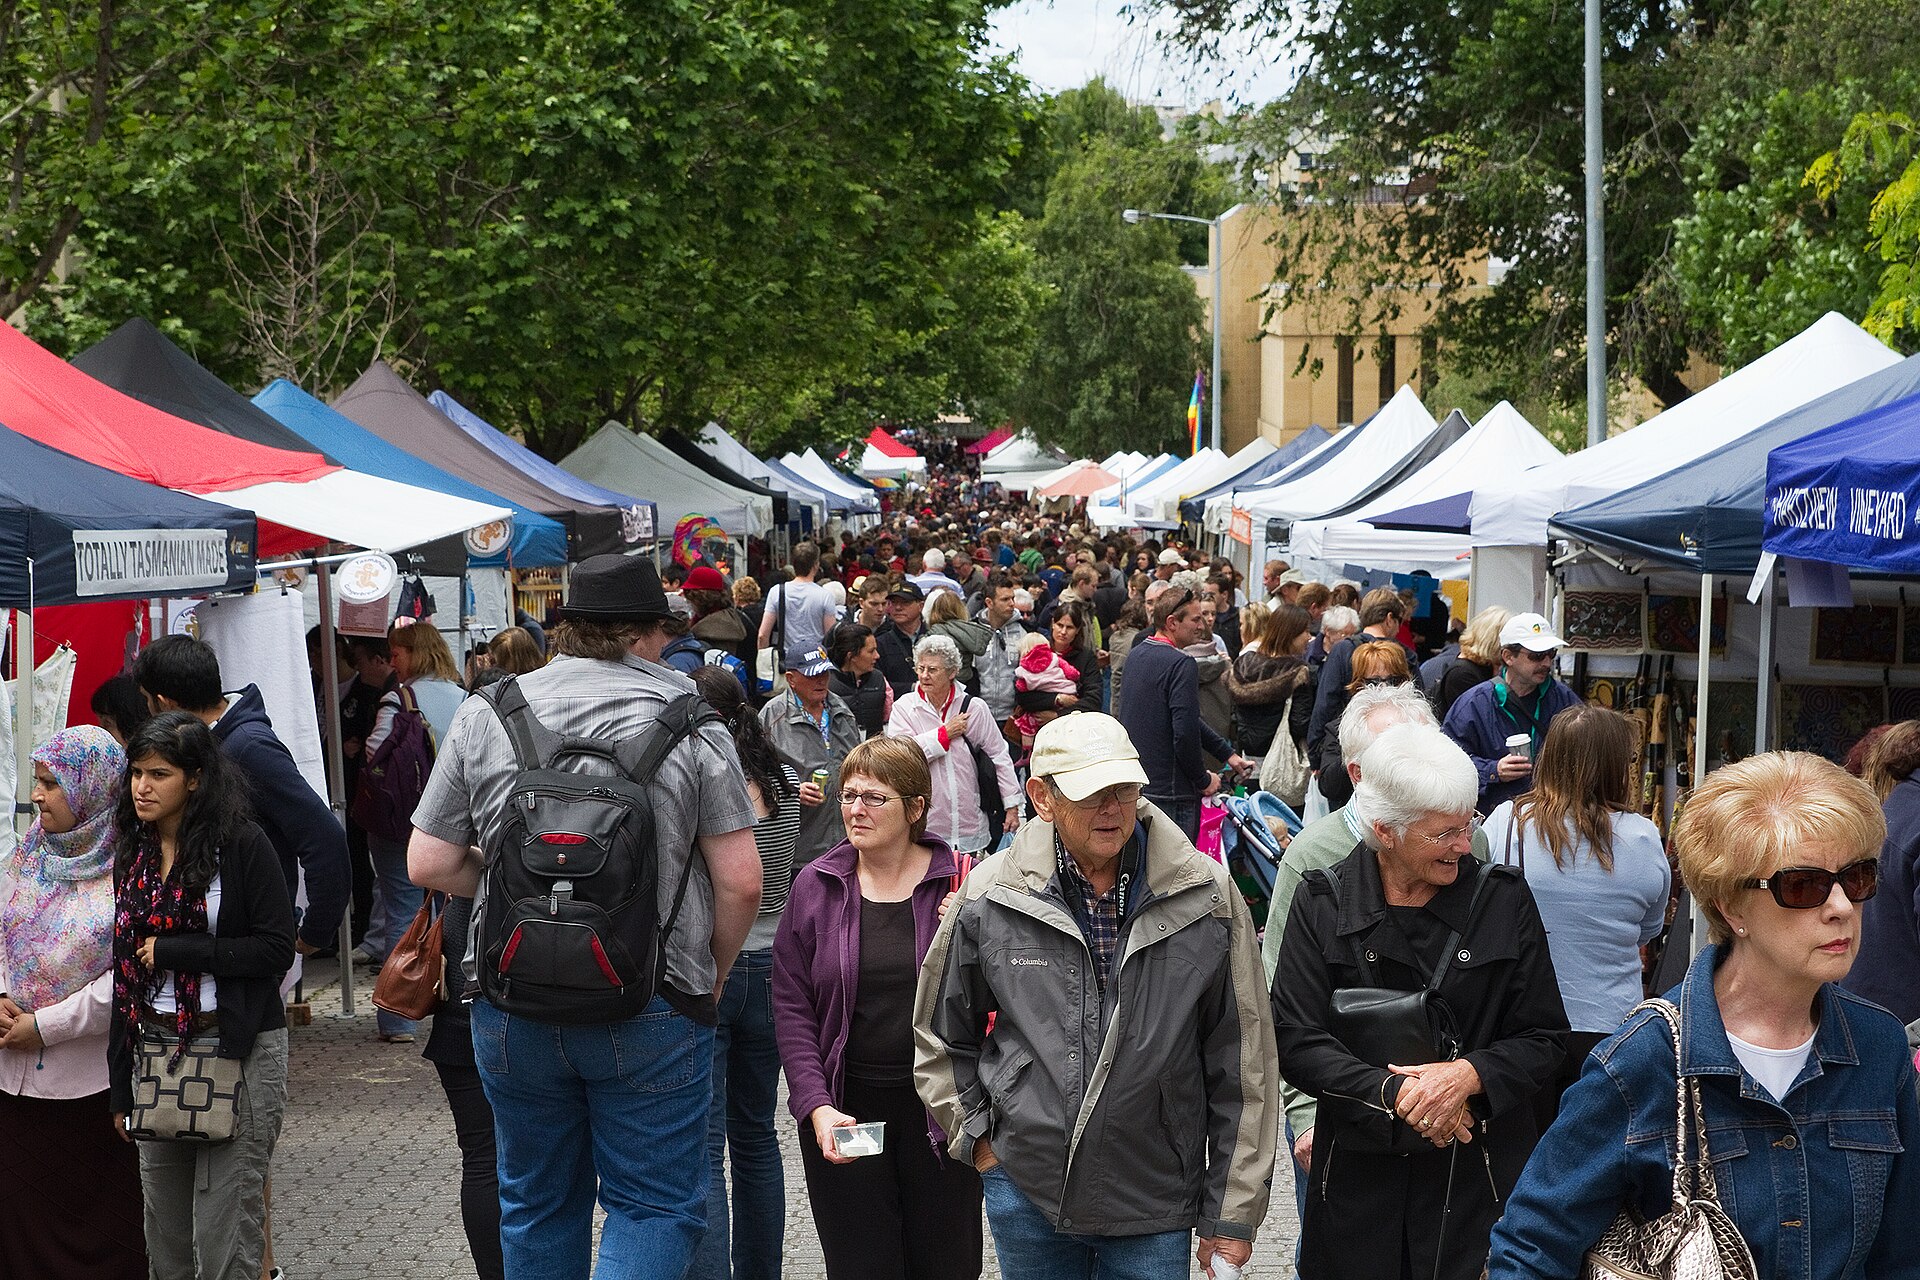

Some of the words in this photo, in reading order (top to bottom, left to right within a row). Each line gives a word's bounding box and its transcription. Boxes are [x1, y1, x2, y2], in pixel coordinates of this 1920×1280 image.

[1850, 488, 1906, 539] VINEYARD
[76, 541, 128, 582] TOTALLY
[129, 540, 196, 579] TASMANIAN
[197, 539, 225, 575] MADE
[804, 650, 820, 662] NAVY
[1118, 873, 1130, 916] Canon
[1018, 958, 1048, 967] Columbia
